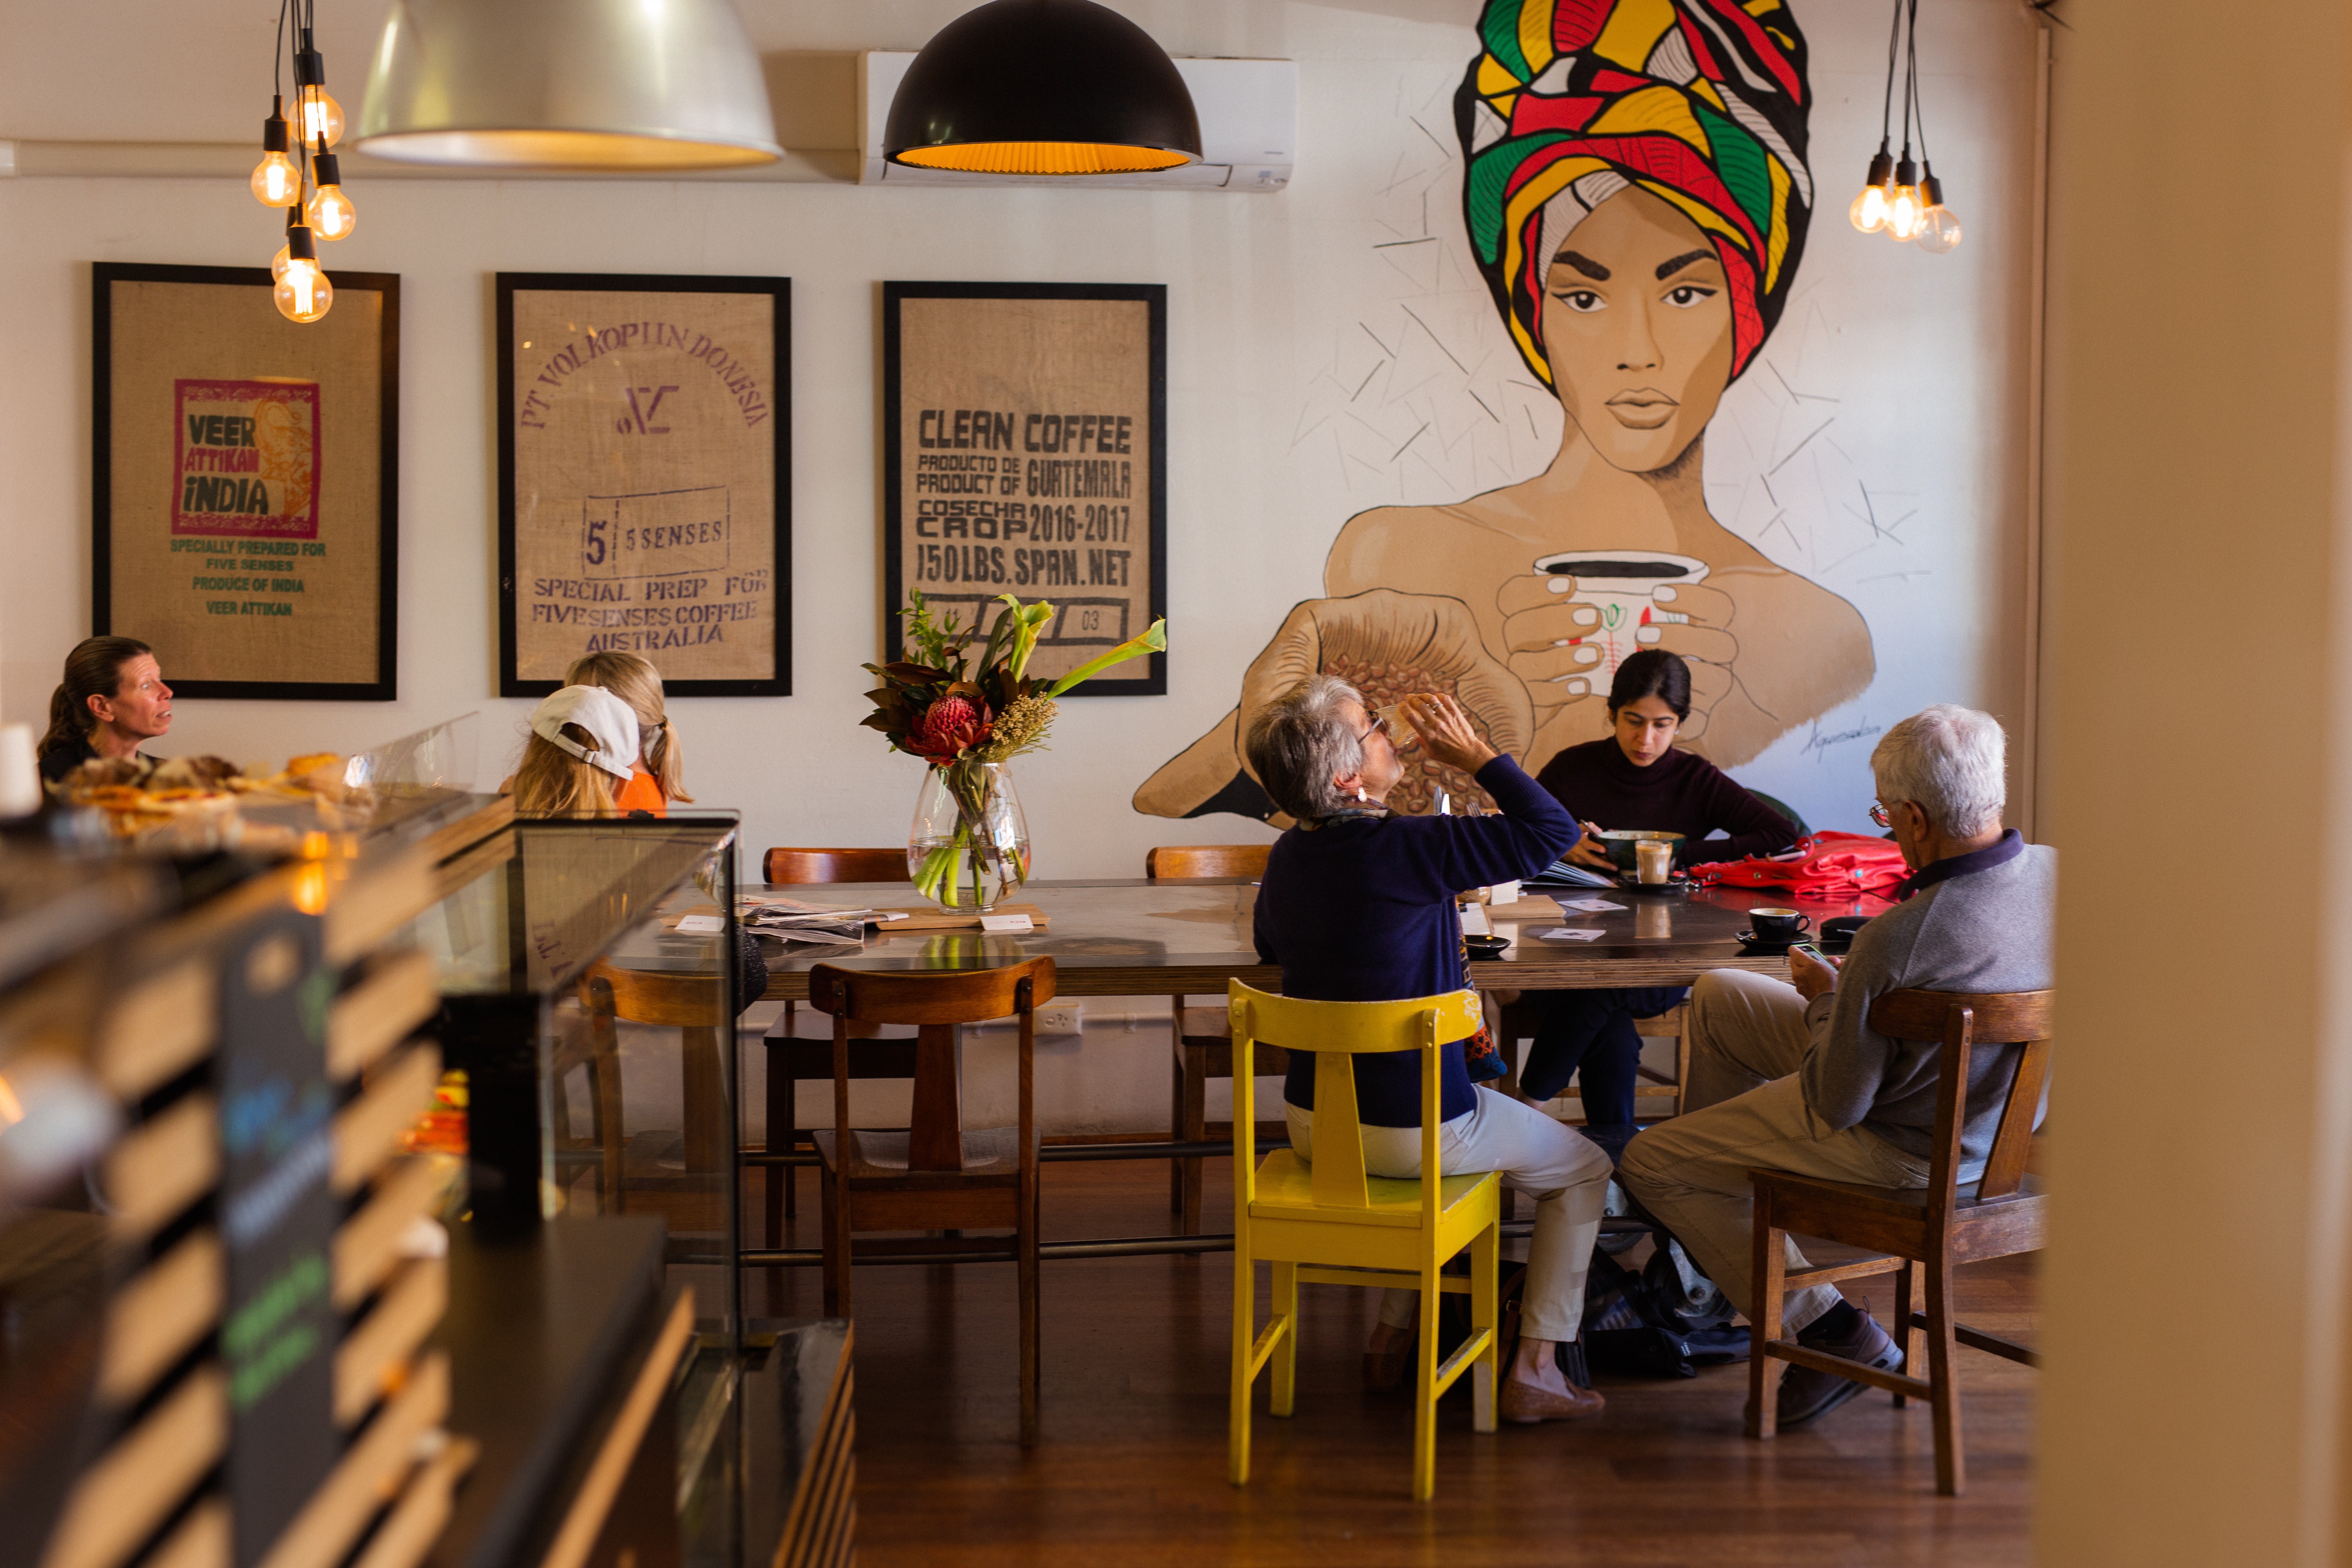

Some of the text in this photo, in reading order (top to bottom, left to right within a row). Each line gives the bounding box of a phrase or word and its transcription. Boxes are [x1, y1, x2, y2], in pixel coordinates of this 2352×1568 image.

[188, 414, 256, 447] VEER
[919, 409, 1132, 455] CLEAN COFFEE
[184, 447, 260, 473] ATTIKAN
[918, 455, 1021, 474] PRODUCTO DE
[917, 473, 1021, 496] PRODUCT OF
[1027, 458, 1132, 499] GUATEMALA
[918, 500, 1026, 519] COSECHA
[916, 517, 1027, 540] CROP
[1030, 504, 1130, 543] 2016-2017
[170, 539, 326, 557] SPECIALLY PREPARED FOR
[586, 521, 607, 565] 5
[206, 558, 294, 571] FIVE SENSES
[192, 576, 305, 593] PRODUCE OF INDIA
[534, 578, 631, 602] SPECIAL
[645, 578, 708, 600] PREP
[206, 601, 293, 616] VEER ATTIKAN
[675, 600, 758, 624] COFFEE
[1082, 610, 1100, 631] 03
[586, 624, 723, 652] AUSTRALIA
